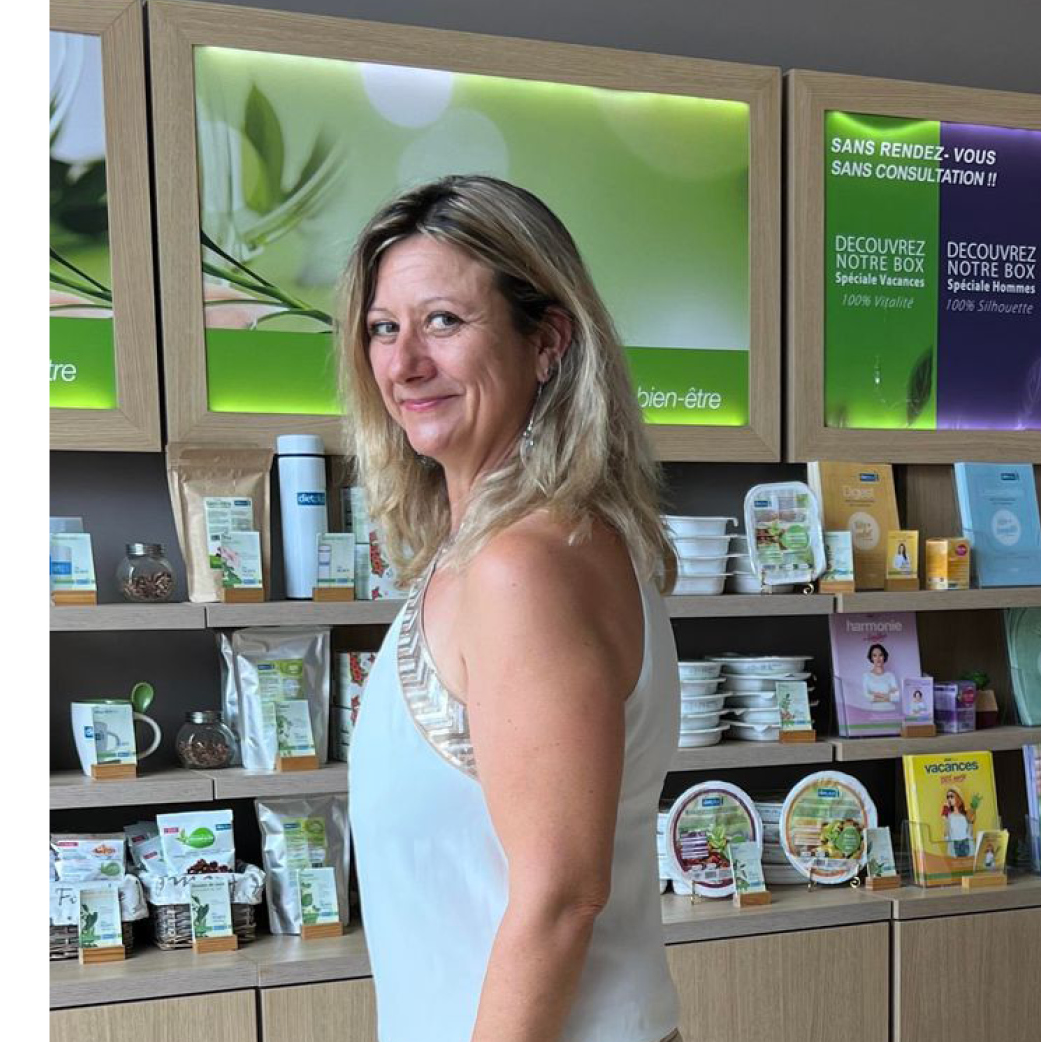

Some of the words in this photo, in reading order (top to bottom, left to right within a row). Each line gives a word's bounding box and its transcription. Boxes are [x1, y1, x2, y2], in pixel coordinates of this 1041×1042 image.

[831, 137, 875, 156] SANS
[954, 147, 997, 165] VOUS
[831, 160, 872, 178] SANS
[875, 164, 986, 186] CONSULTATION
[835, 235, 926, 256] DECOUVREZ
[947, 241, 1037, 263] DECOUVREZ
[835, 254, 887, 272] NOTRE
[894, 256, 924, 273] BOX
[947, 260, 999, 278] NOTRE
[1005, 263, 1036, 280] BOX
[835, 271, 878, 285] Spéciale
[880, 274, 925, 288] Vacances
[947, 278, 991, 293] Spéciale
[992, 281, 1036, 294] Hommes
[946, 298, 975, 312] 100%
[978, 299, 1034, 315] Silhouette
[637, 385, 722, 410] bien-être
[846, 619, 903, 632] harmonie
[924, 760, 979, 775] vacances
